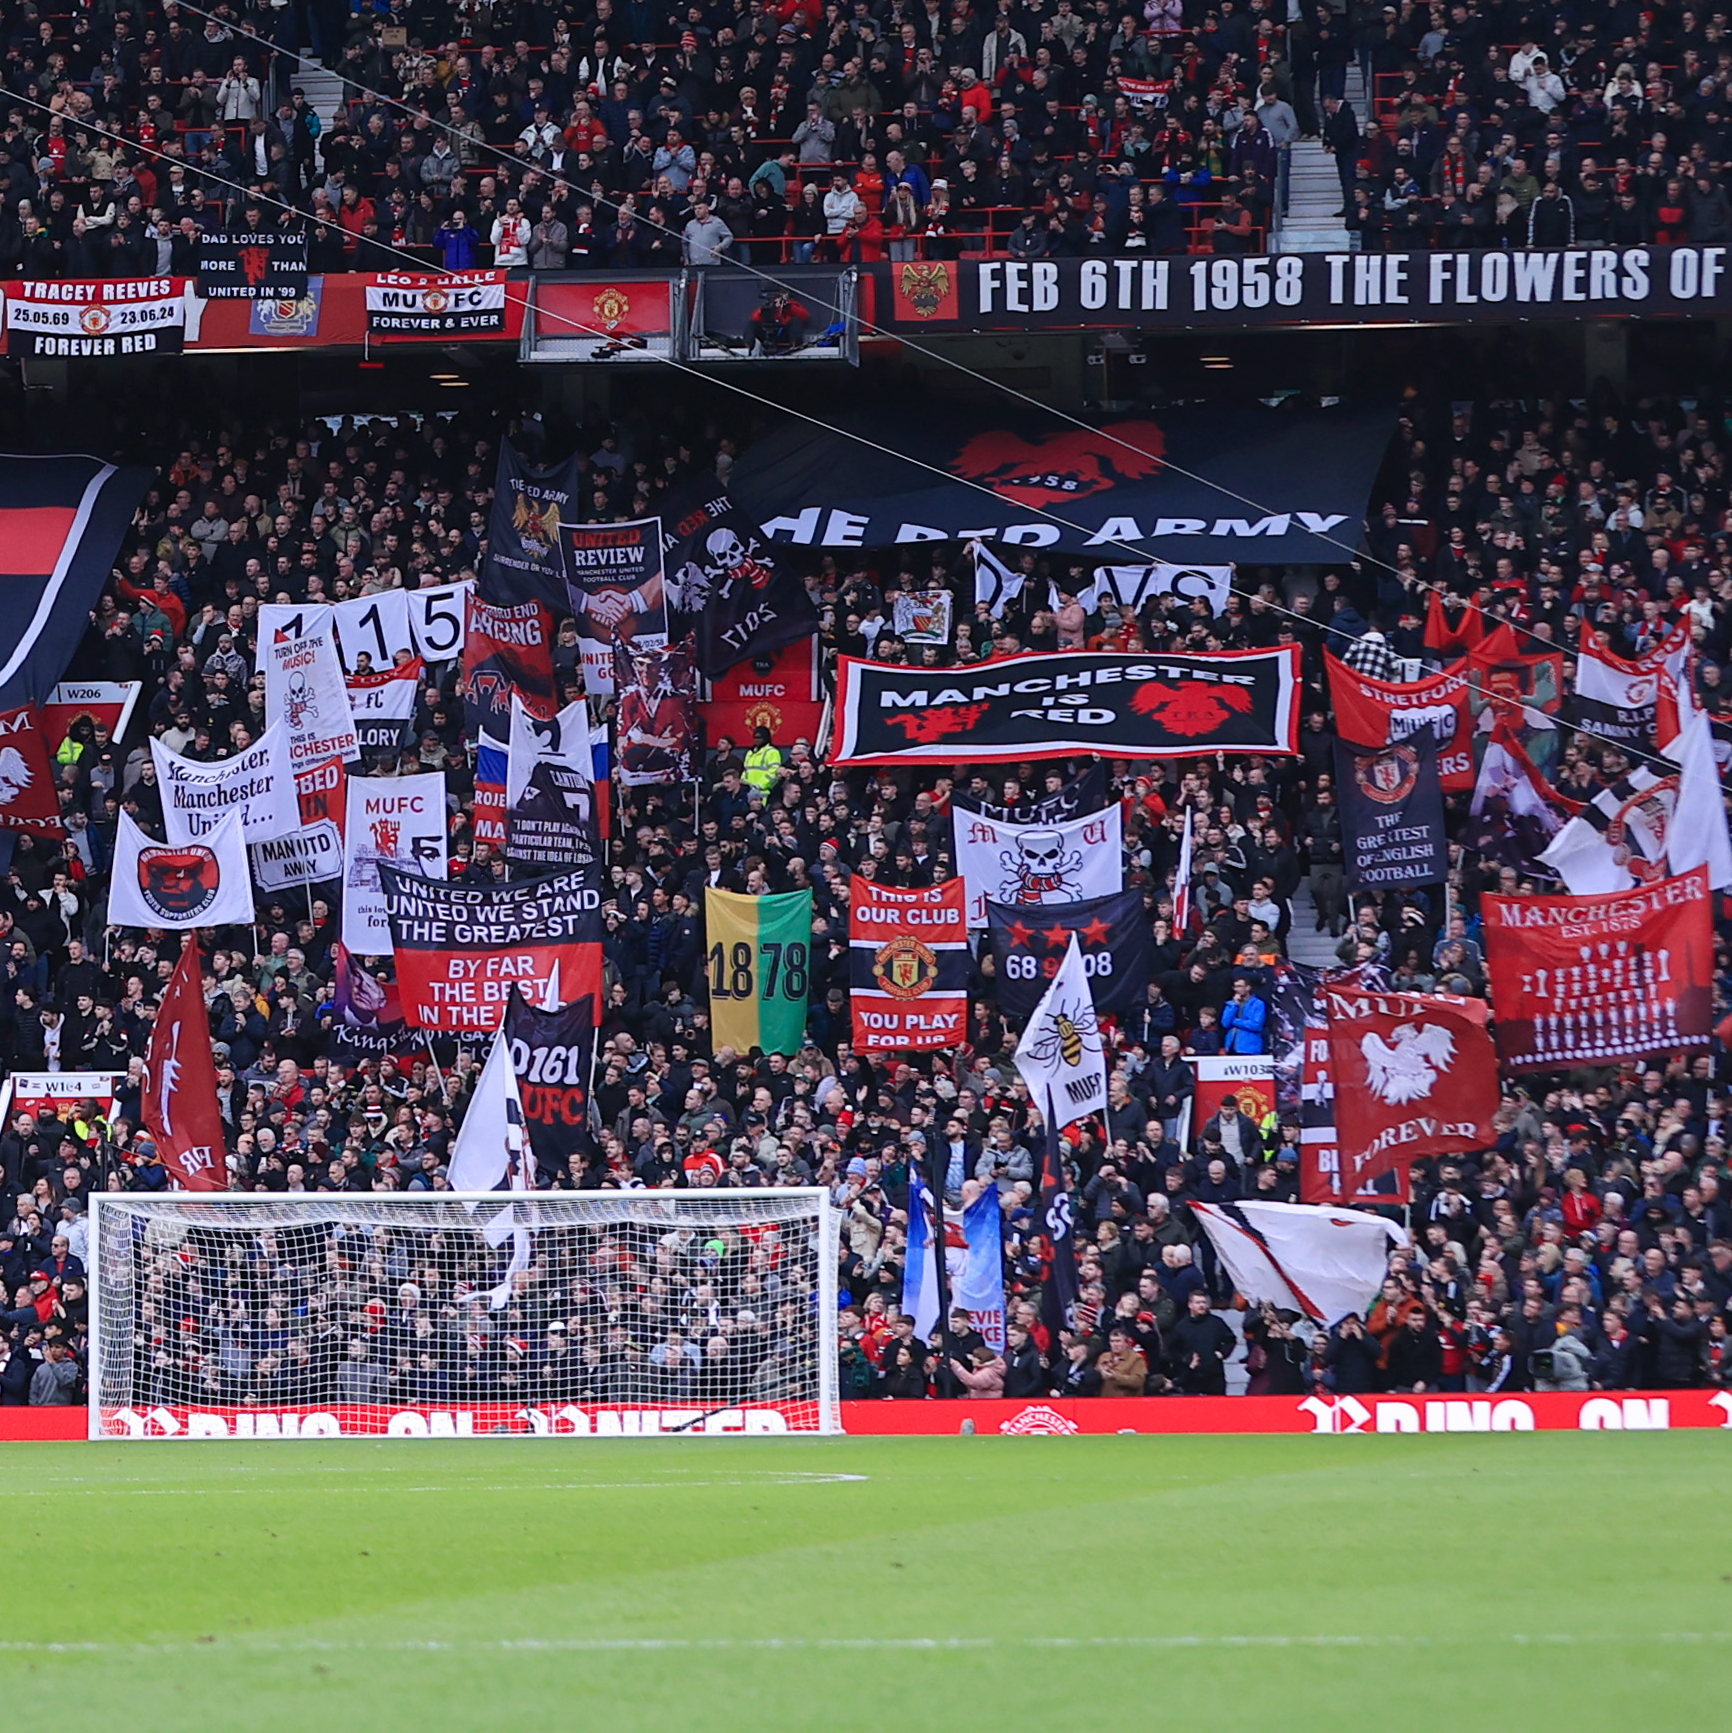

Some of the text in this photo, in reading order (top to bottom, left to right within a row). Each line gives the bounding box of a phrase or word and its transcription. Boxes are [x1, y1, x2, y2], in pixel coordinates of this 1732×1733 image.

[202, 234, 228, 244] DAD
[232, 234, 275, 245] LOVES
[200, 261, 307, 272] MORE THAN
[22, 279, 171, 302] TRACEY REEVES
[208, 286, 274, 297] UNITED IN
[979, 248, 1727, 314] FEB 6TH 1958 THE FLOWERS OF
[382, 291, 483, 309] MU FC
[14, 306, 175, 326] 25.05.69 23.06.24
[372, 315, 499, 329] FOREVER & EVER
[35, 334, 156, 356] FOREVER RED
[573, 529, 640, 547] UNITED
[1082, 511, 1351, 547] ARMY
[574, 546, 645, 566] REVIEW
[67, 688, 102, 700] W206
[739, 683, 786, 697] MUFC
[880, 664, 1256, 708] MANCHESTER
[173, 775, 274, 809] Manchester
[364, 795, 425, 815] MUFC
[262, 839, 295, 863] MAN
[394, 869, 585, 905] UNITED ARE
[385, 888, 600, 924] UNITED WE STAND
[1499, 874, 1705, 929] MANCHESTER
[856, 905, 960, 925] OUR CLUB
[398, 914, 579, 944] THE GREATEST
[449, 955, 535, 979] BY FAR
[1006, 954, 1038, 979] 68
[430, 978, 548, 1003] THE BEST
[418, 1004, 495, 1026] IN THE
[858, 1011, 959, 1030] YOU PLAY
[332, 1023, 397, 1054] Kings
[1353, 1117, 1476, 1172] FOREVER
